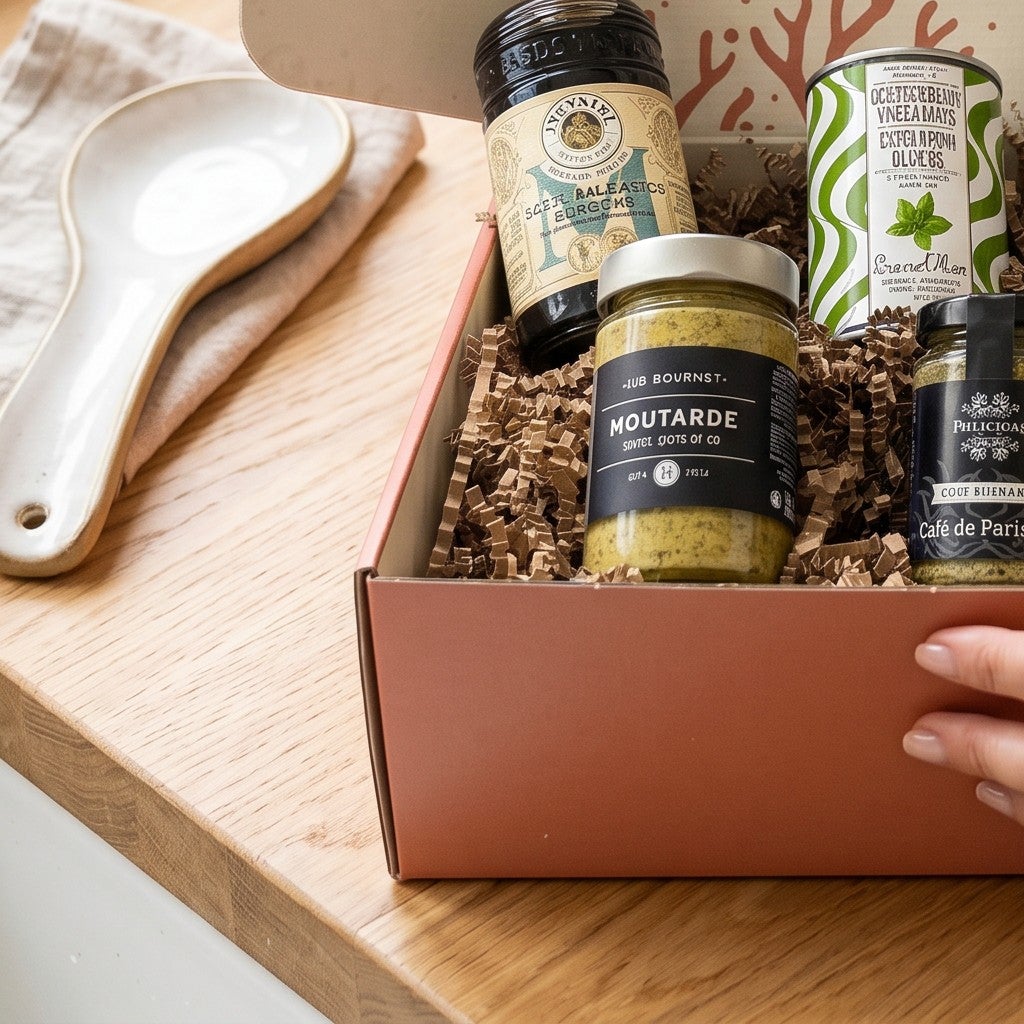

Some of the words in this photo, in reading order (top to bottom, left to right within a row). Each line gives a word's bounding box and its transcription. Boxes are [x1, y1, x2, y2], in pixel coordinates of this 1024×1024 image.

[609, 408, 738, 437] MOUTARDE
[919, 519, 949, 539] Café
[954, 518, 975, 536] de
